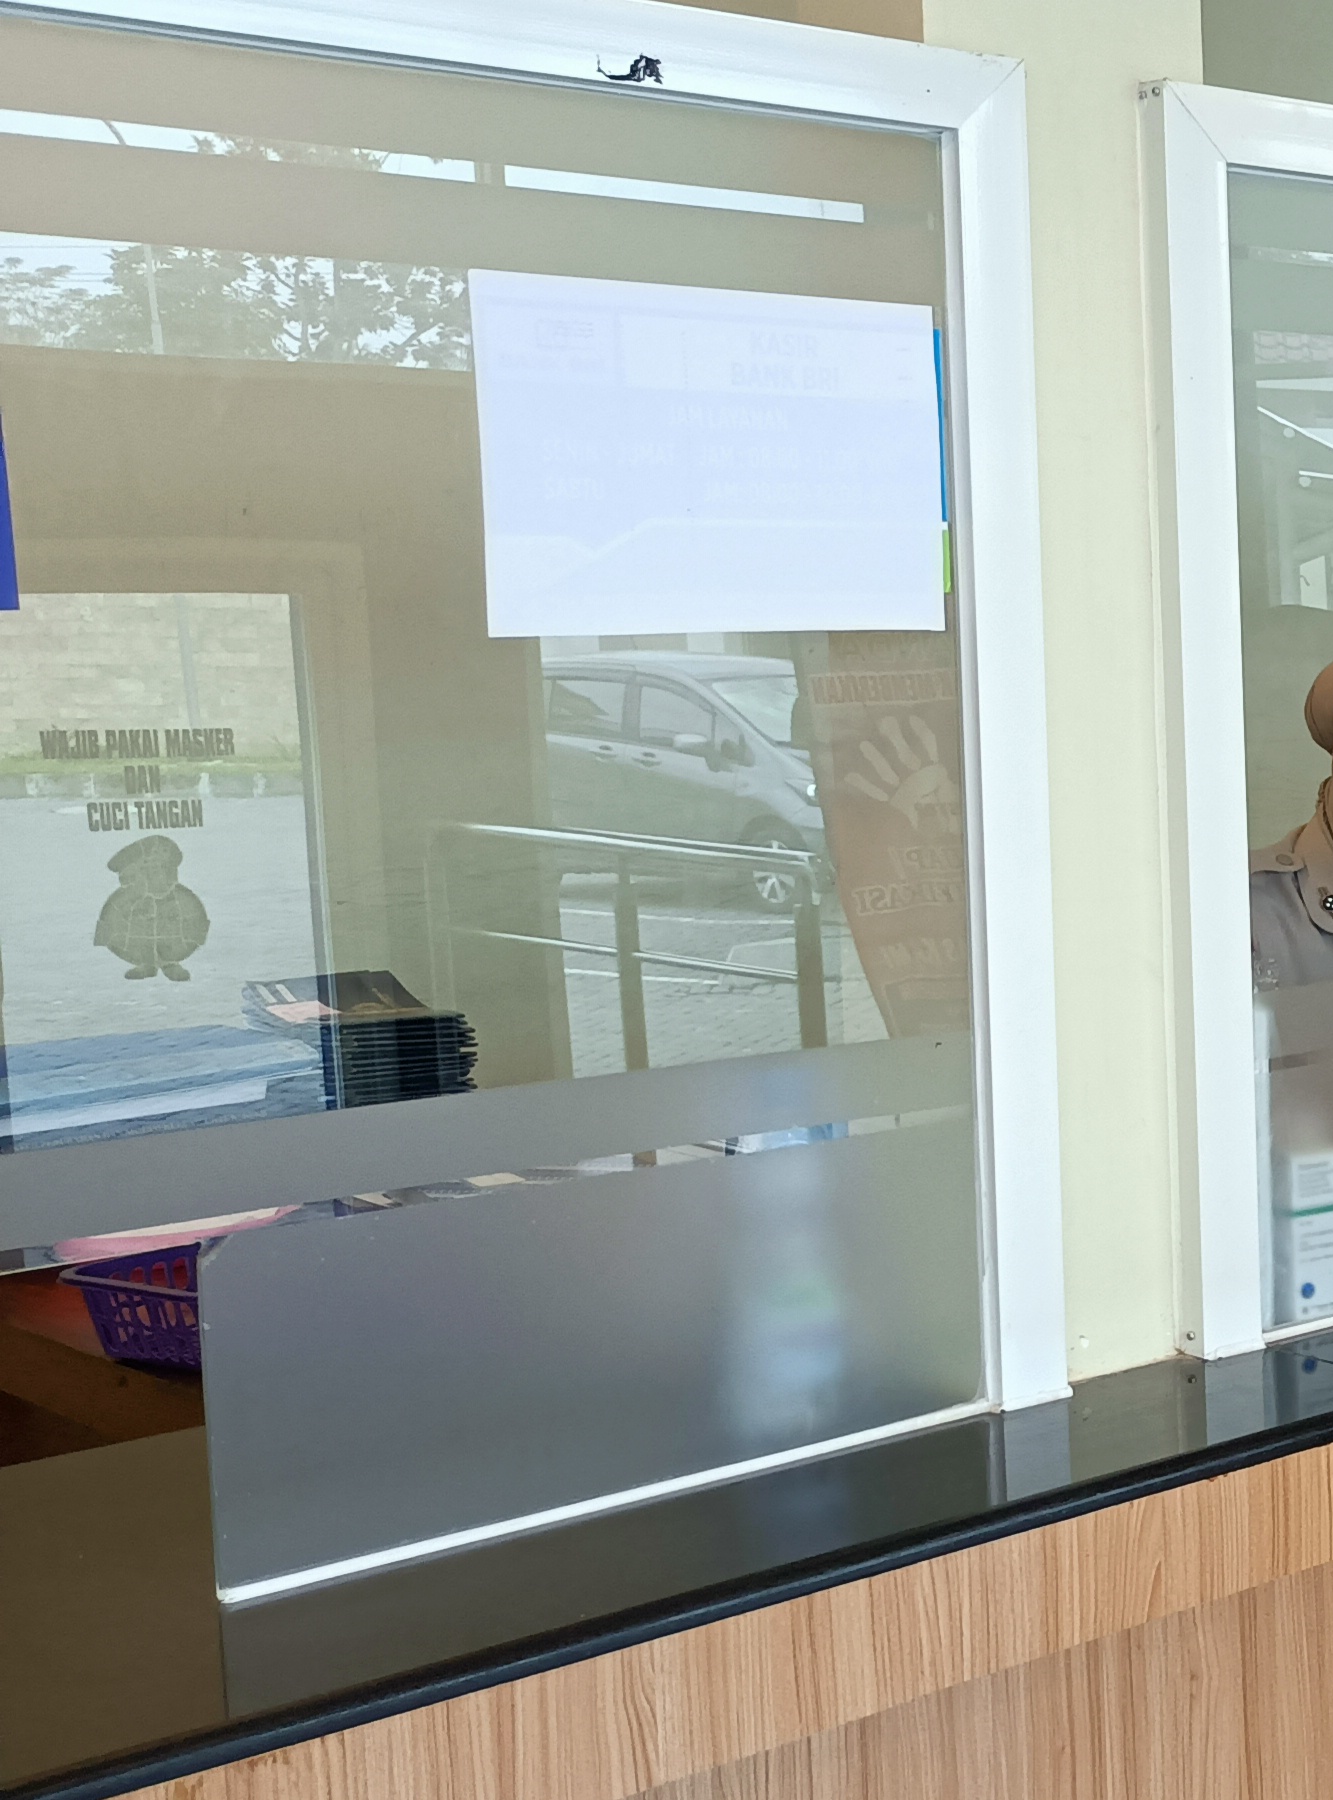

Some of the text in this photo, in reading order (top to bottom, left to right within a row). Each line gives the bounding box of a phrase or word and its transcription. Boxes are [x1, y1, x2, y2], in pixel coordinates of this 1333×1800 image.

[39, 727, 235, 760] WAJIB PAKAI MASKER
[124, 765, 161, 794] DAN
[87, 799, 203, 832] CUCI TANGAN
